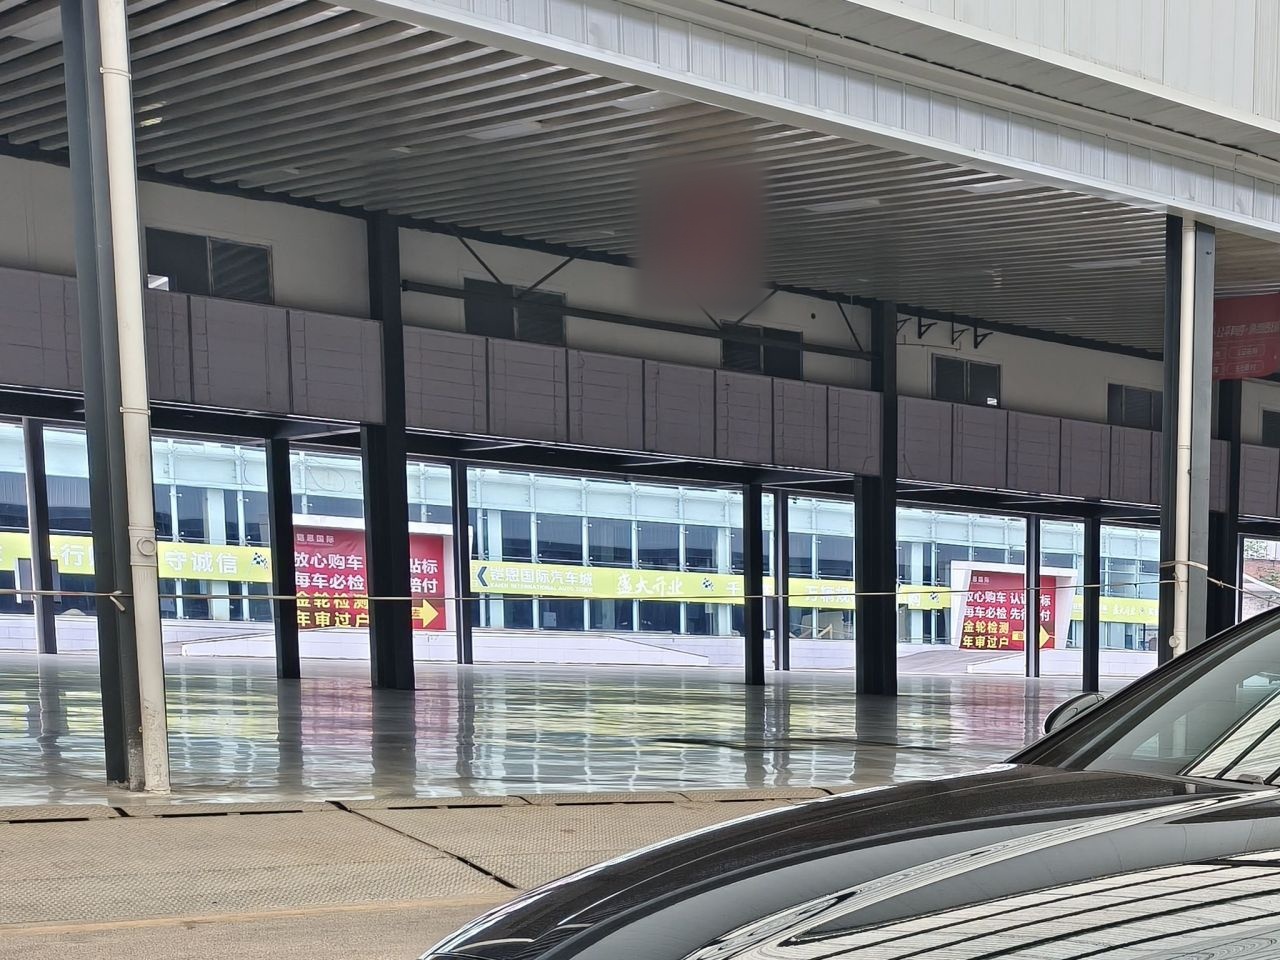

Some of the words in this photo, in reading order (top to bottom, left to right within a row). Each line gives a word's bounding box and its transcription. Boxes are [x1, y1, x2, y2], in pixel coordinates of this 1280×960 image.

[164, 551, 238, 574] 守诚信
[294, 551, 363, 570] 放心购车
[295, 572, 365, 590] 每车必检
[296, 591, 368, 609] 金轮检测
[297, 611, 369, 628] 年审过户
[963, 620, 1010, 634] 金轮检测
[962, 635, 1009, 648] 年审过户
